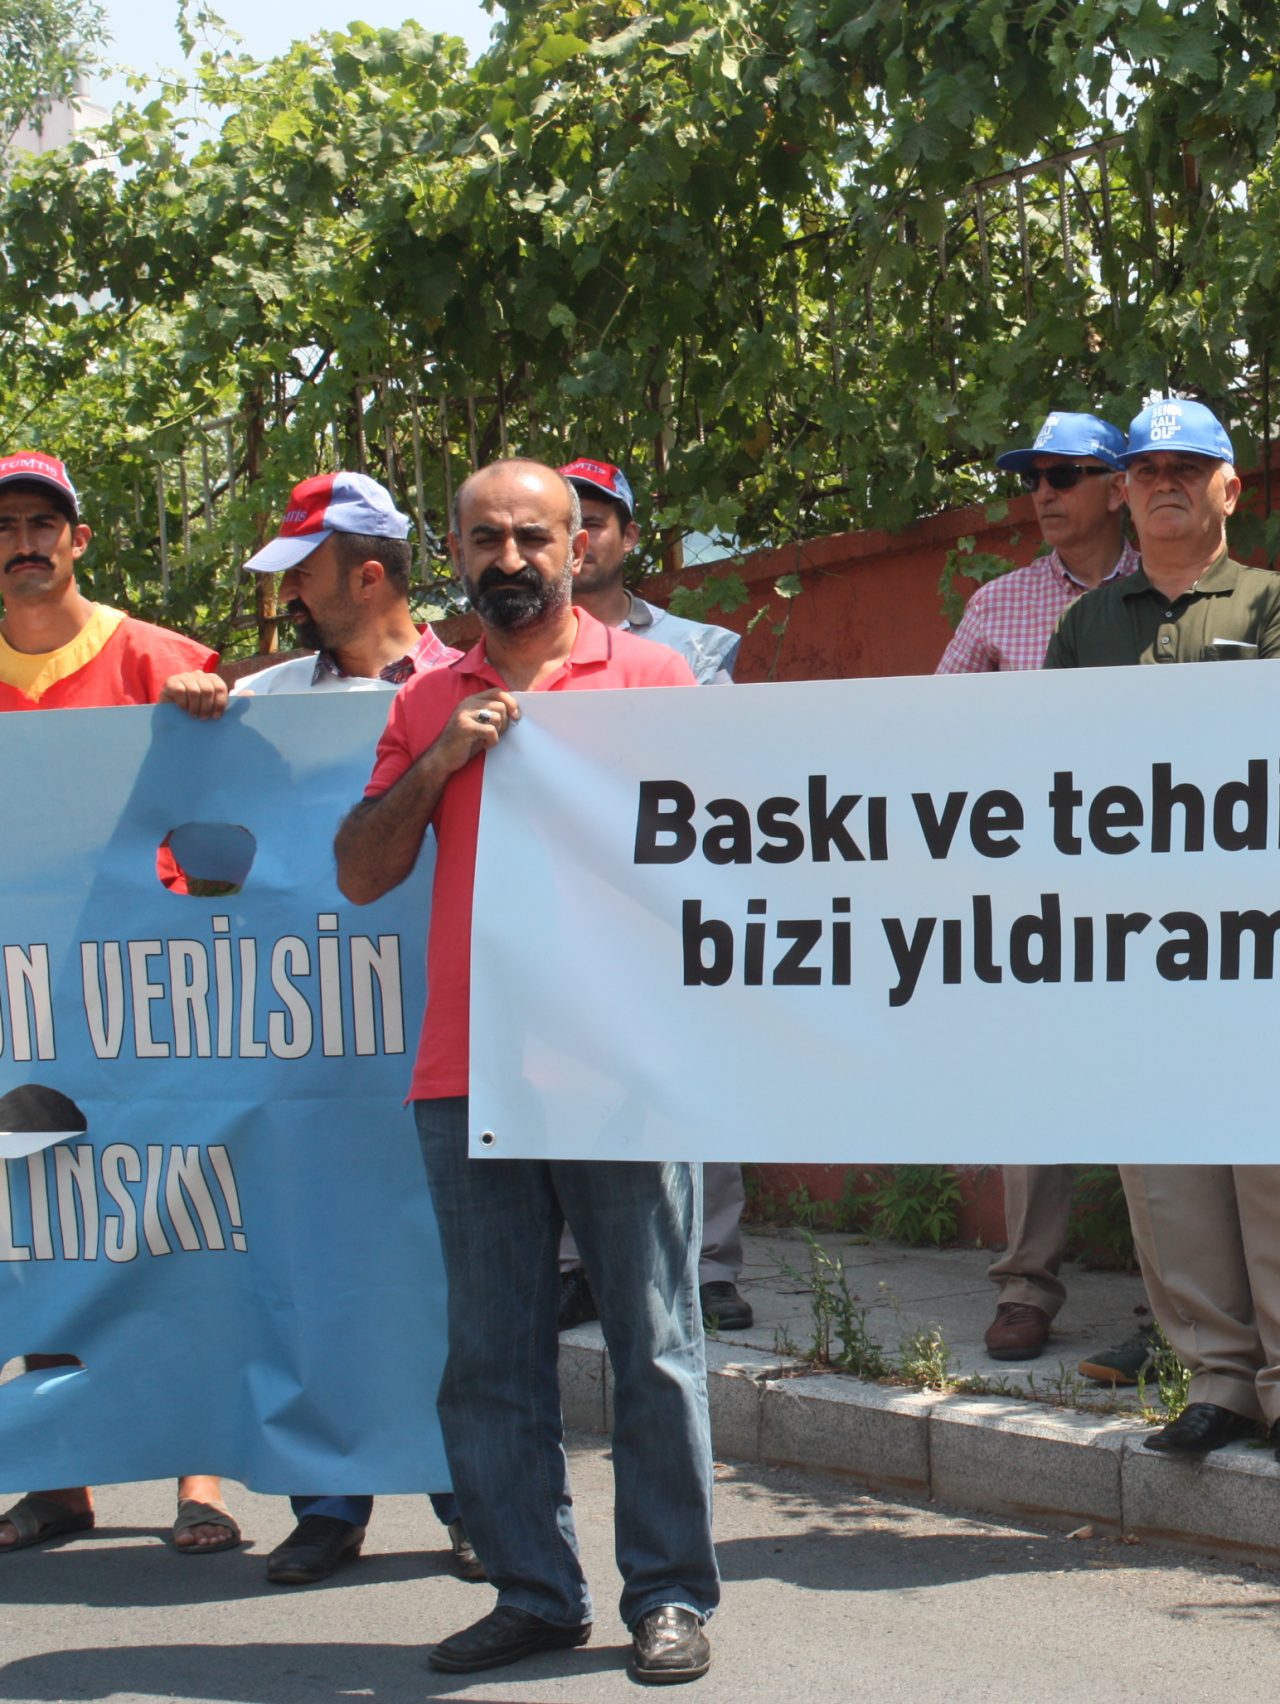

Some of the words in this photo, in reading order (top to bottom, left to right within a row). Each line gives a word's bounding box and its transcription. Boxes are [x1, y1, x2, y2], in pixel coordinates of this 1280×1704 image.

[634, 775, 888, 864] Baskı
[912, 790, 1024, 859] ve
[683, 897, 851, 986] bizi
[80, 913, 406, 1060] VERİLSİN
